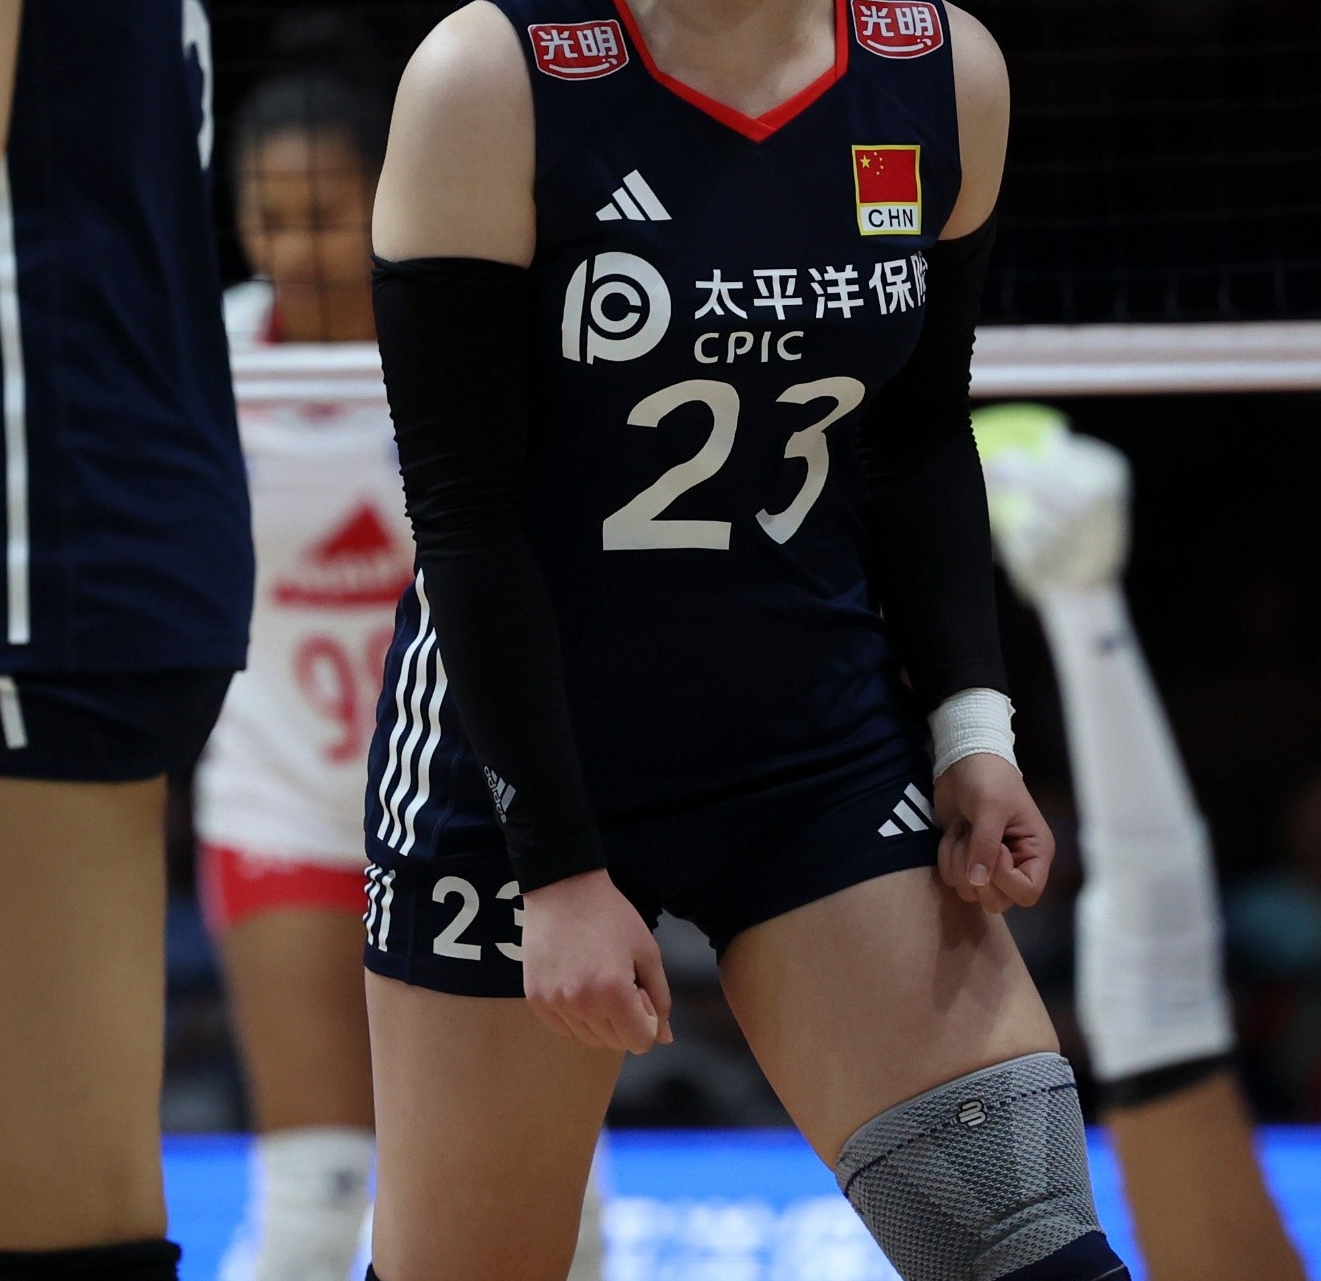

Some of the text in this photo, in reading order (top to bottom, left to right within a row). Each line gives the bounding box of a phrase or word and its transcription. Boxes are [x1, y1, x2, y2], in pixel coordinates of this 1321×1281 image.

[859, 5, 934, 37] 光明
[538, 26, 619, 60] 光明
[868, 208, 914, 228] CHN
[693, 330, 805, 364] CPIC
[602, 376, 866, 551] 23
[483, 765, 507, 824] adidas
